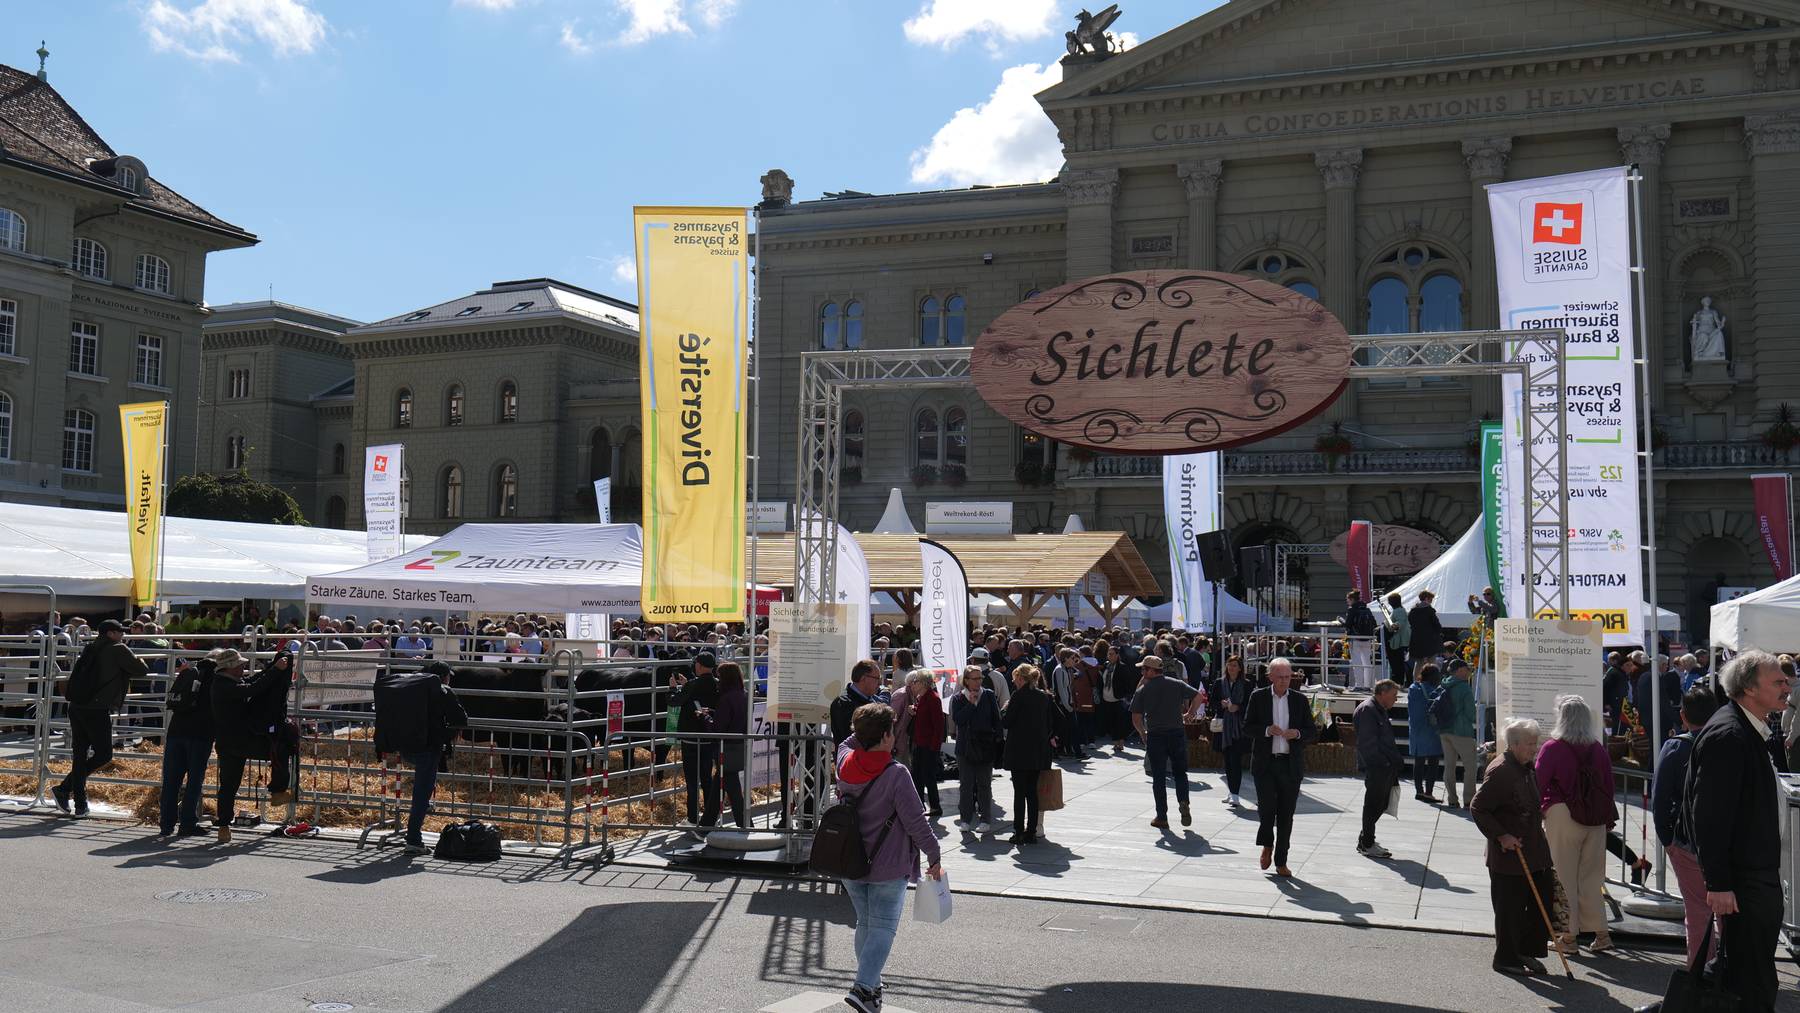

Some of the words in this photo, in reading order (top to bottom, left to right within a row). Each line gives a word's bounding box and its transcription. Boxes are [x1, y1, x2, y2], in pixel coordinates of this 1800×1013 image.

[1152, 121, 1229, 142] CURIA
[1245, 96, 1507, 134] CONFOEDERATIONIS
[1525, 77, 1705, 110] HELVETICAE
[95, 296, 139, 312] NAZIONALE
[1030, 319, 1275, 386] Sichlete
[453, 555, 620, 571] Zaunteam
[310, 584, 347, 598] Starke
[349, 586, 388, 600] Zäune.
[392, 588, 437, 602] Starkes
[439, 591, 476, 604] Team.
[773, 607, 805, 617] Sichlete
[798, 625, 839, 634] Bundesplatz
[1502, 624, 1545, 636] Sichlete
[1538, 645, 1592, 656] Bundesplatz
